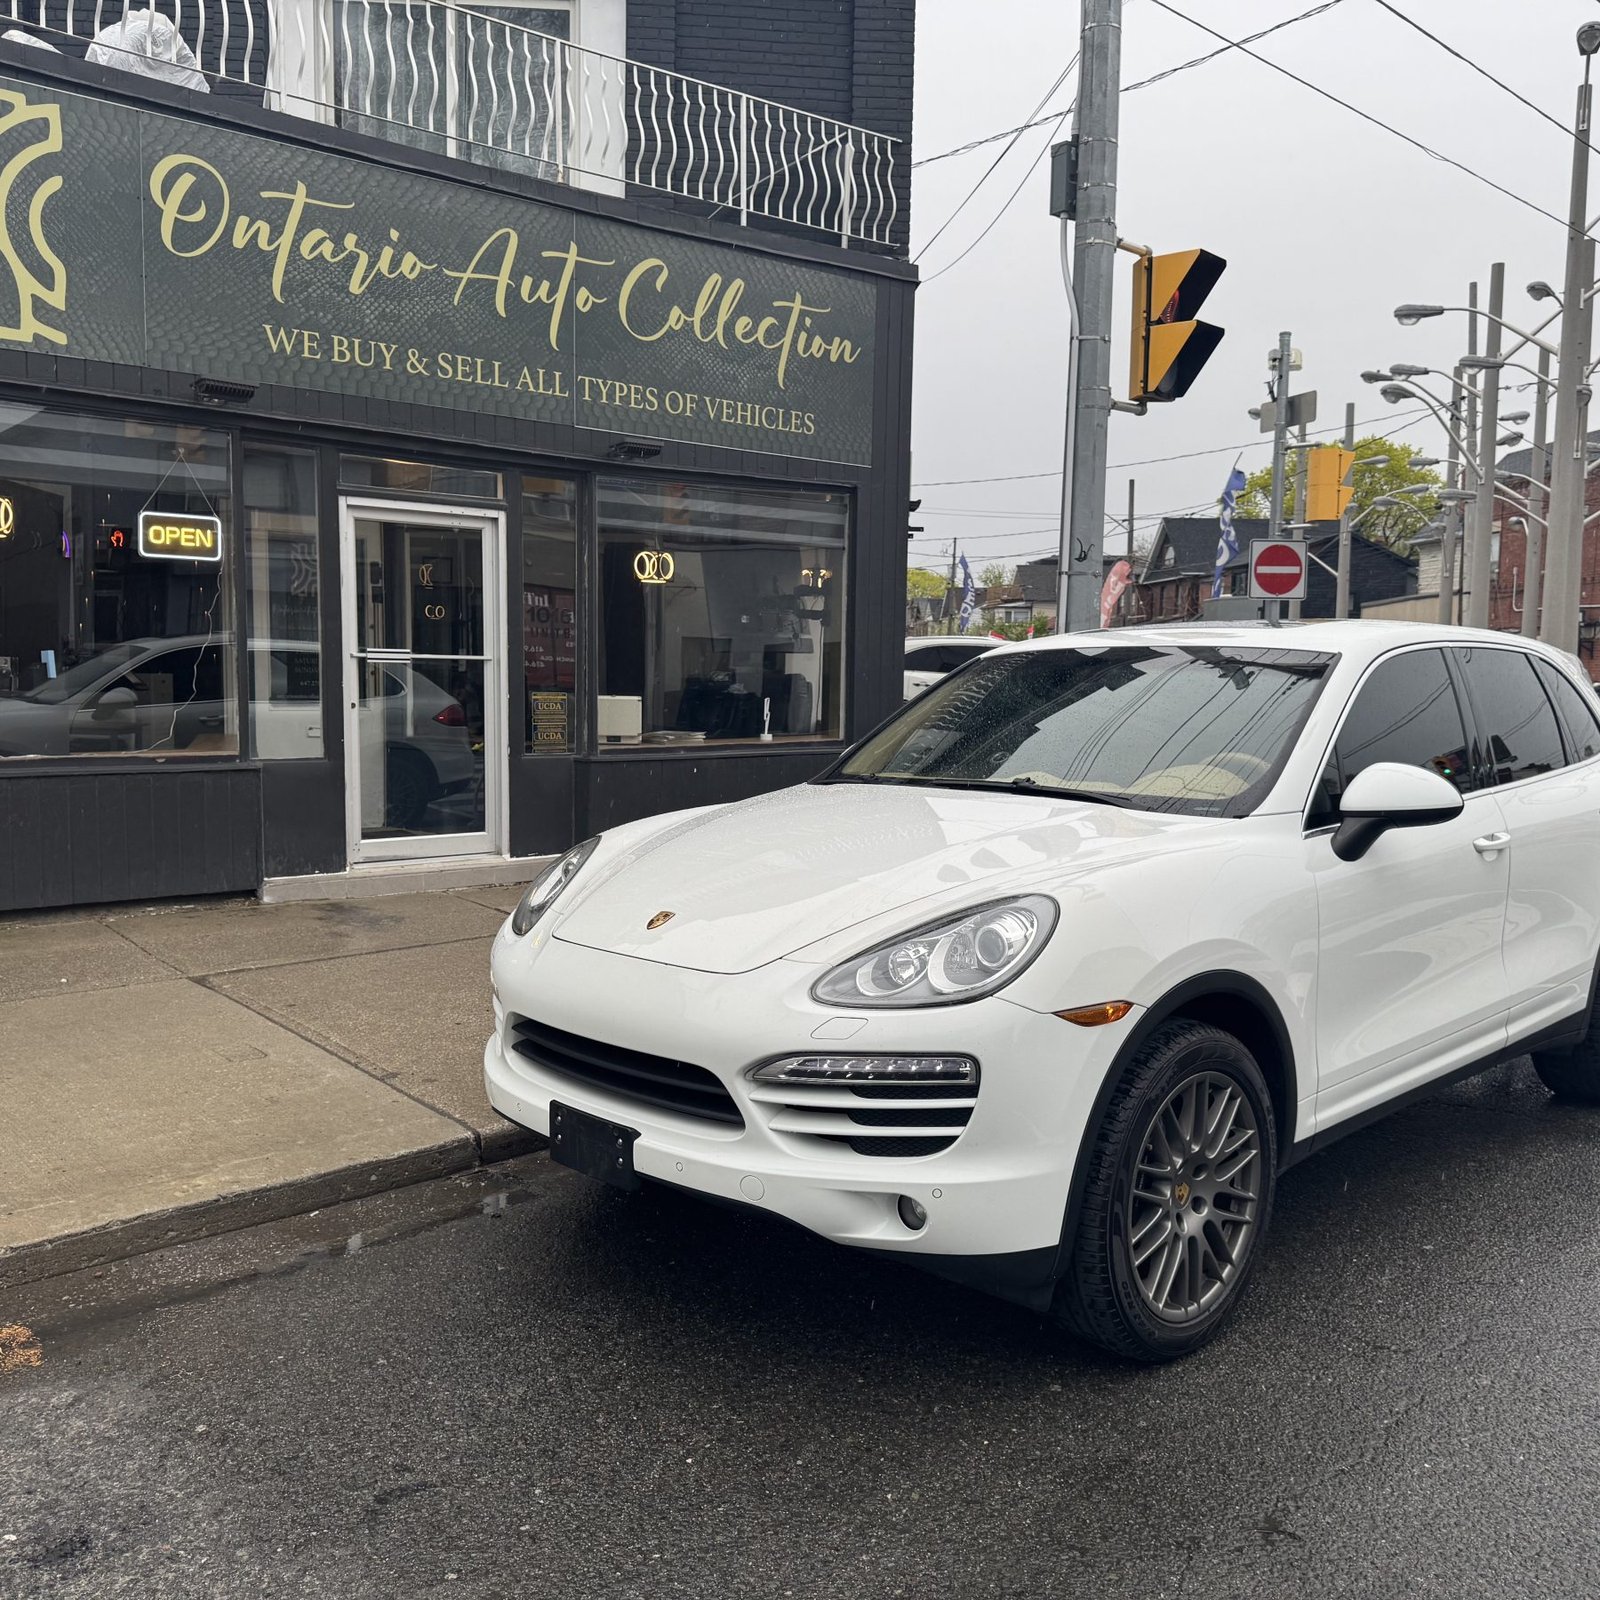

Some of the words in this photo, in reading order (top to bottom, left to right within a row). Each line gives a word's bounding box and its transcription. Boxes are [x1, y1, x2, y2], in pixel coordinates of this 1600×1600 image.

[149, 153, 438, 304] Ontario
[442, 227, 616, 352] Auto
[618, 257, 862, 390] Collection
[262, 323, 321, 360] WE
[331, 334, 399, 374] BUY
[405, 348, 431, 377] &
[437, 352, 510, 389] SELL
[515, 367, 570, 398] ALL
[577, 375, 659, 413] TYPES
[664, 389, 698, 417] OF
[703, 396, 816, 435] VEHICLES
[149, 525, 213, 548] OPEN
[538, 702, 562, 710] UCDA
[538, 732, 562, 740] UCDA
